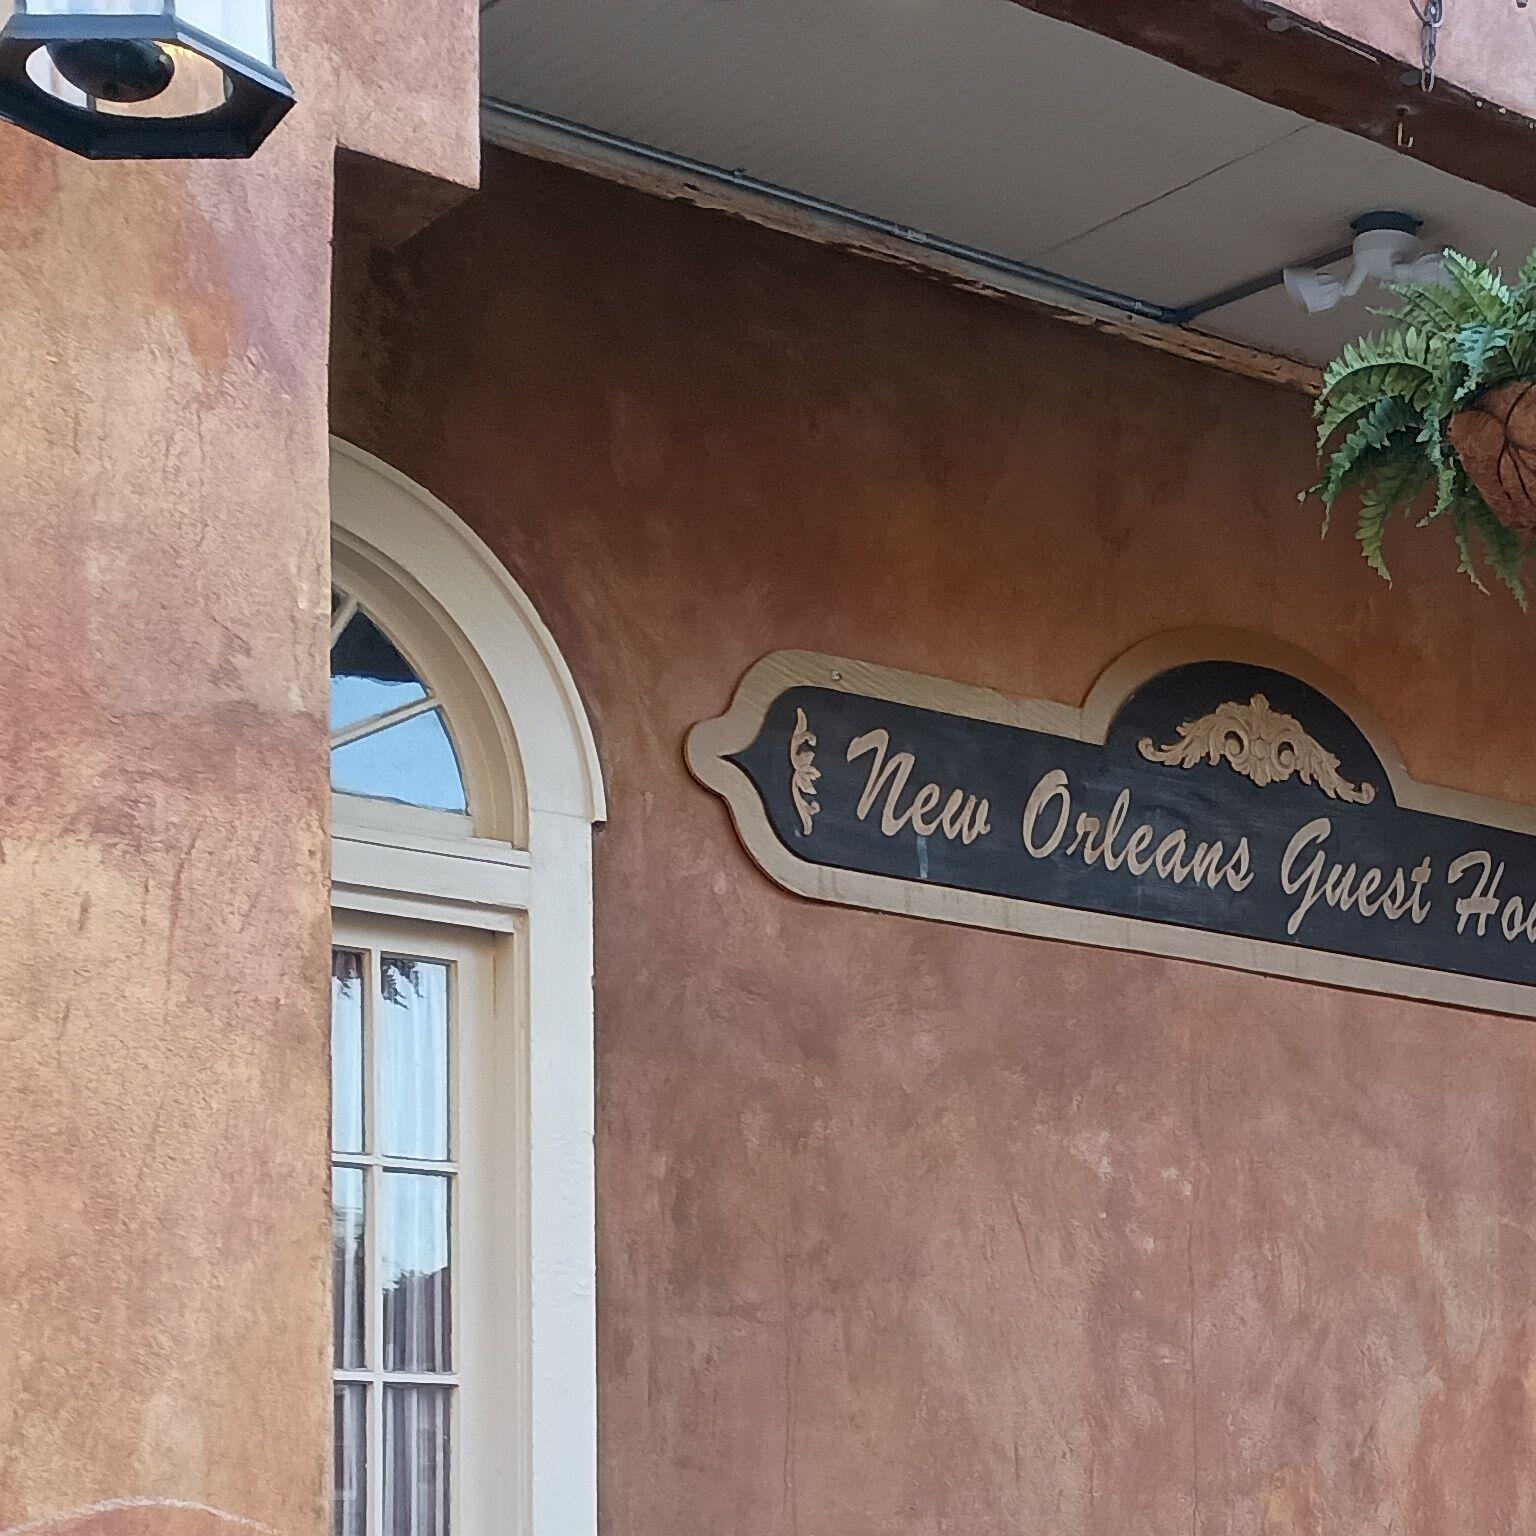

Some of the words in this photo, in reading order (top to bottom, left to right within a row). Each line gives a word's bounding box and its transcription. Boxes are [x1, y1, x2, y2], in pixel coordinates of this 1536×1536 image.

[846, 728, 991, 844] New
[1022, 769, 1255, 892] Orleans
[1281, 817, 1433, 934] Guest
